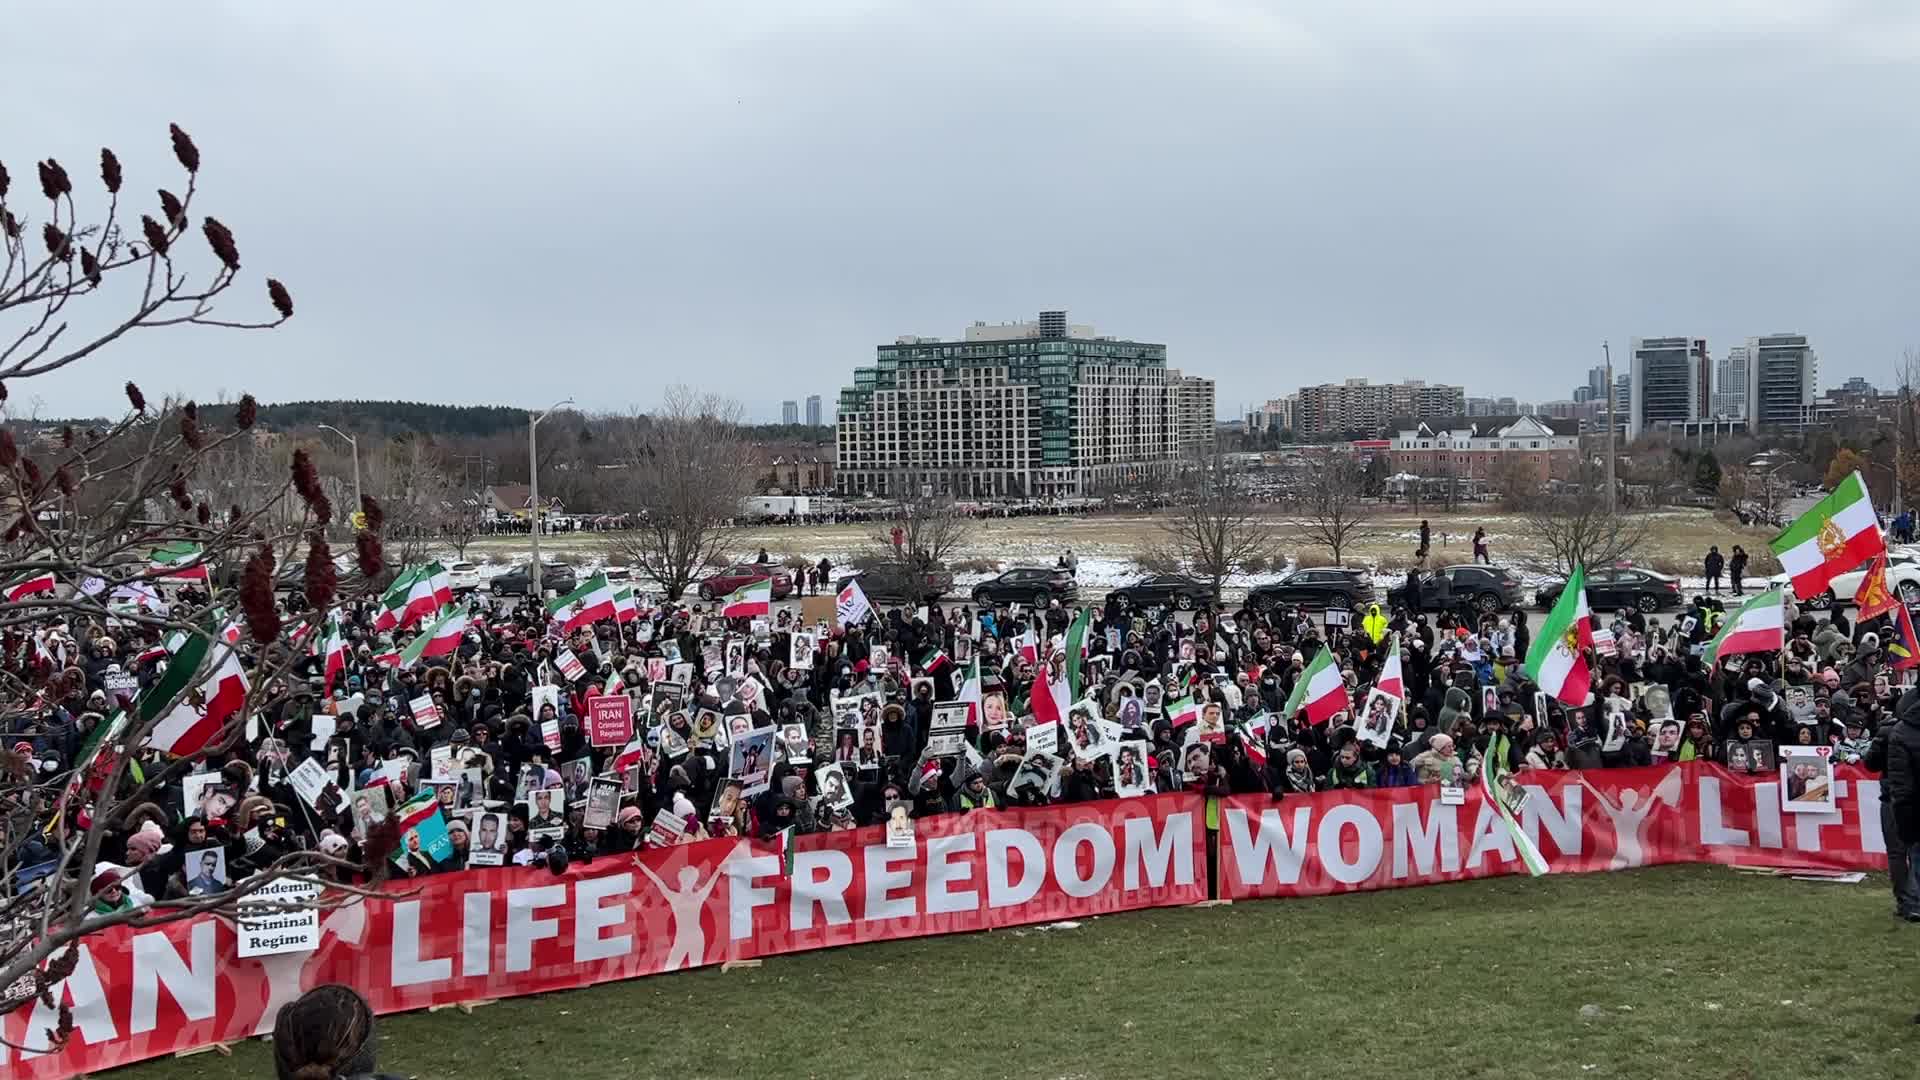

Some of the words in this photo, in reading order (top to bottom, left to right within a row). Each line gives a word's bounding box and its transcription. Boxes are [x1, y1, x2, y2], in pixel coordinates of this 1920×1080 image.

[594, 701, 625, 709] Condemn
[598, 708, 622, 720] IRAN
[597, 720, 625, 729] Criminal
[599, 730, 624, 738] Regime
[1225, 783, 1583, 885] WOMAN
[428, 834, 449, 852] IRAN
[391, 872, 633, 987] LIFE
[728, 809, 1195, 941] FREEDOM
[243, 916, 313, 931] Criminal
[249, 935, 308, 949] Regime
